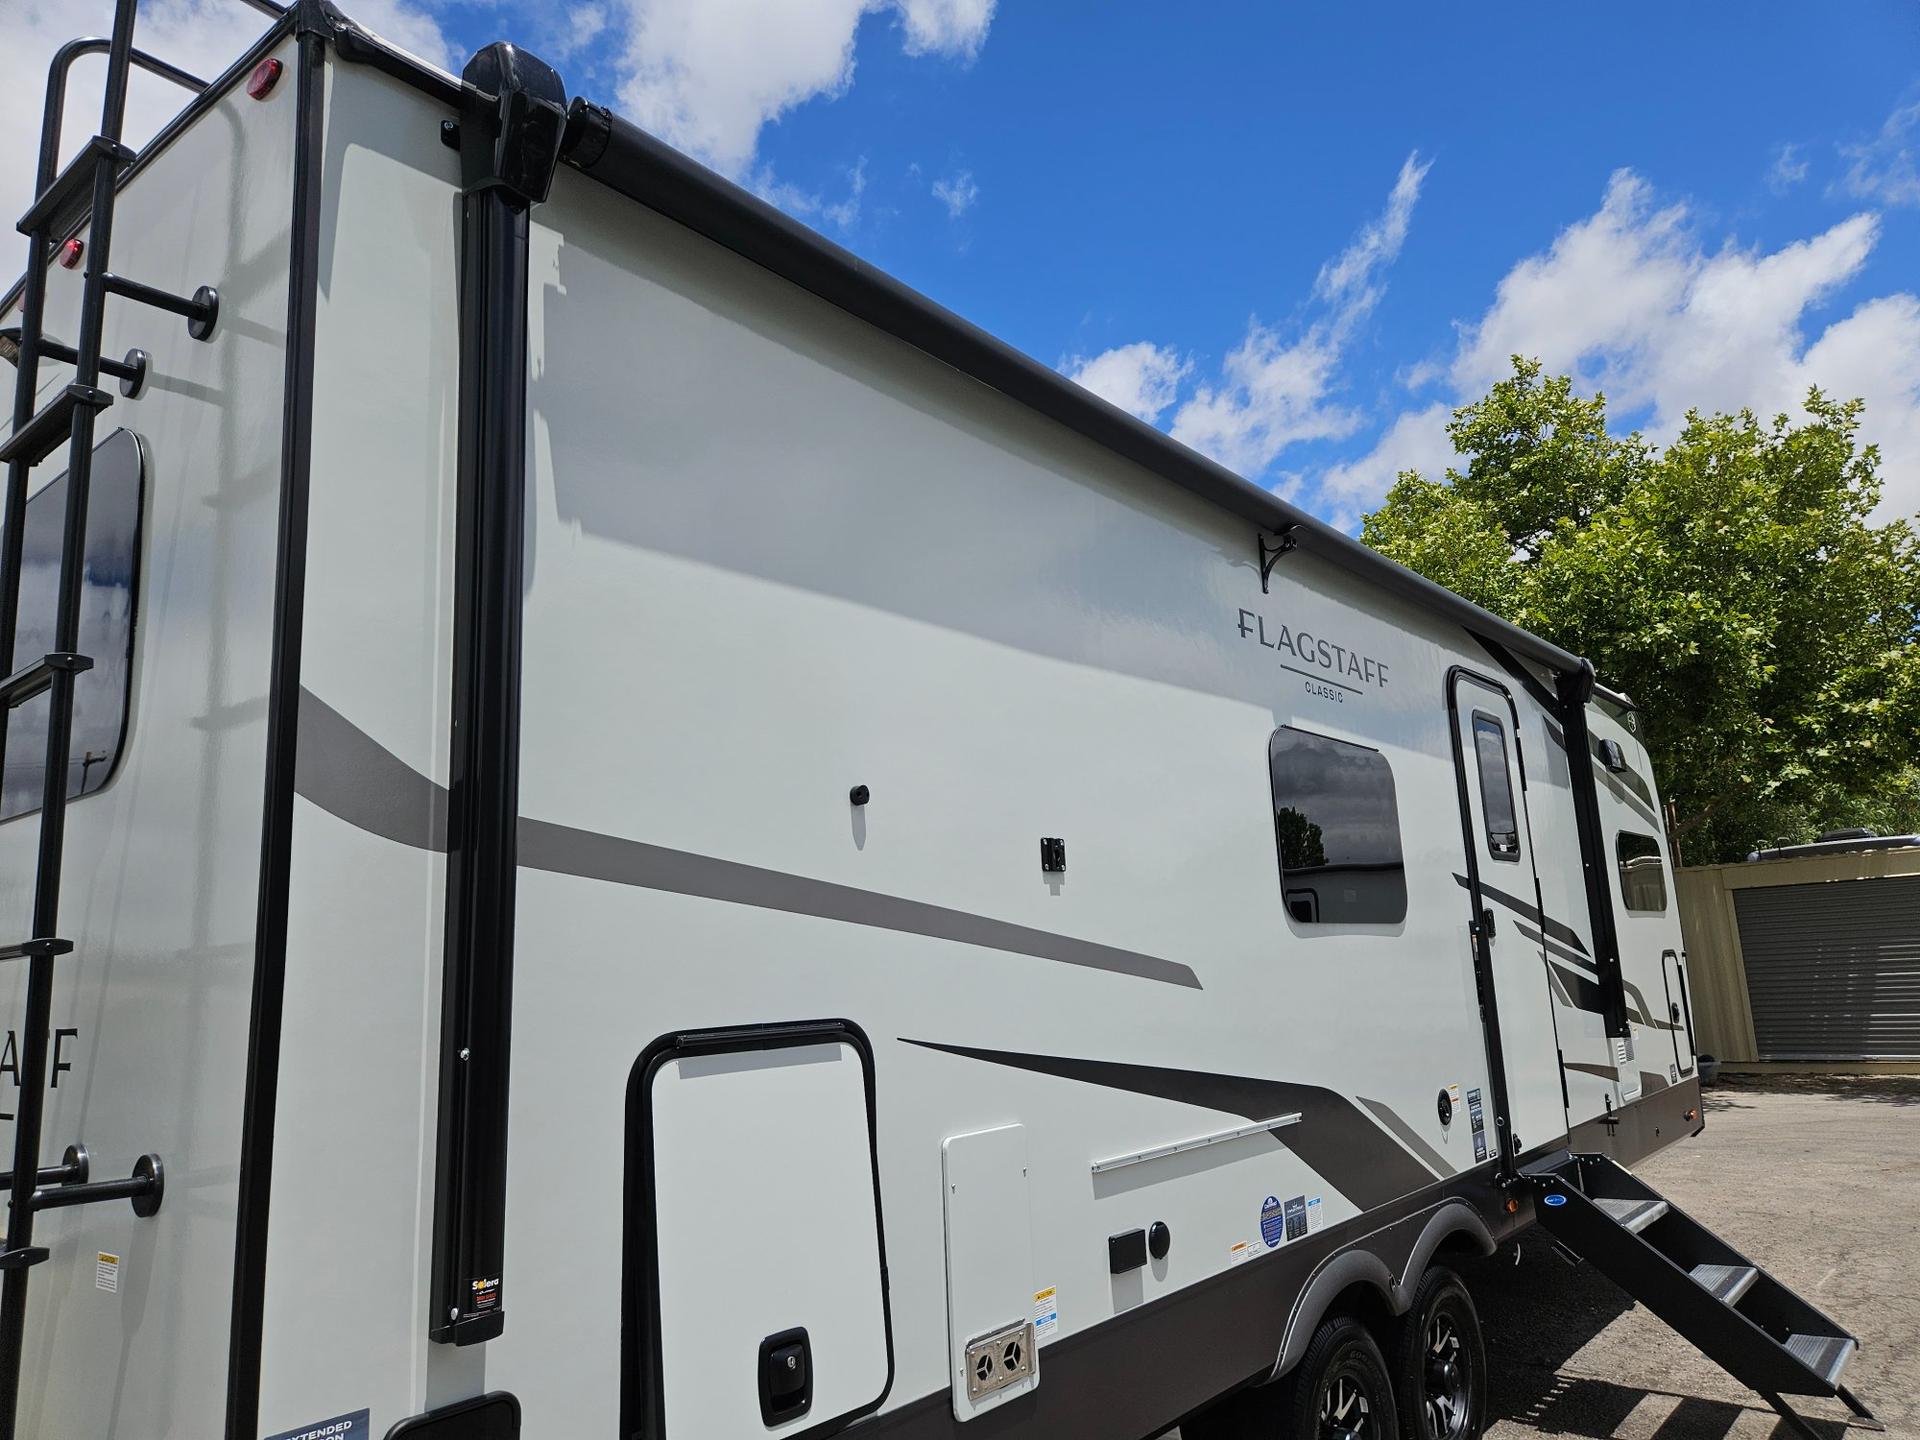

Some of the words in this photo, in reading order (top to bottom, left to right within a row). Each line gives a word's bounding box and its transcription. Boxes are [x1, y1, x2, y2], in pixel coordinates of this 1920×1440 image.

[1237, 607, 1390, 688] FLAGSTAFF
[1304, 681, 1344, 704] CLASSIC
[472, 1278, 500, 1290] Solera
[284, 1420, 352, 1440] XTENDED
